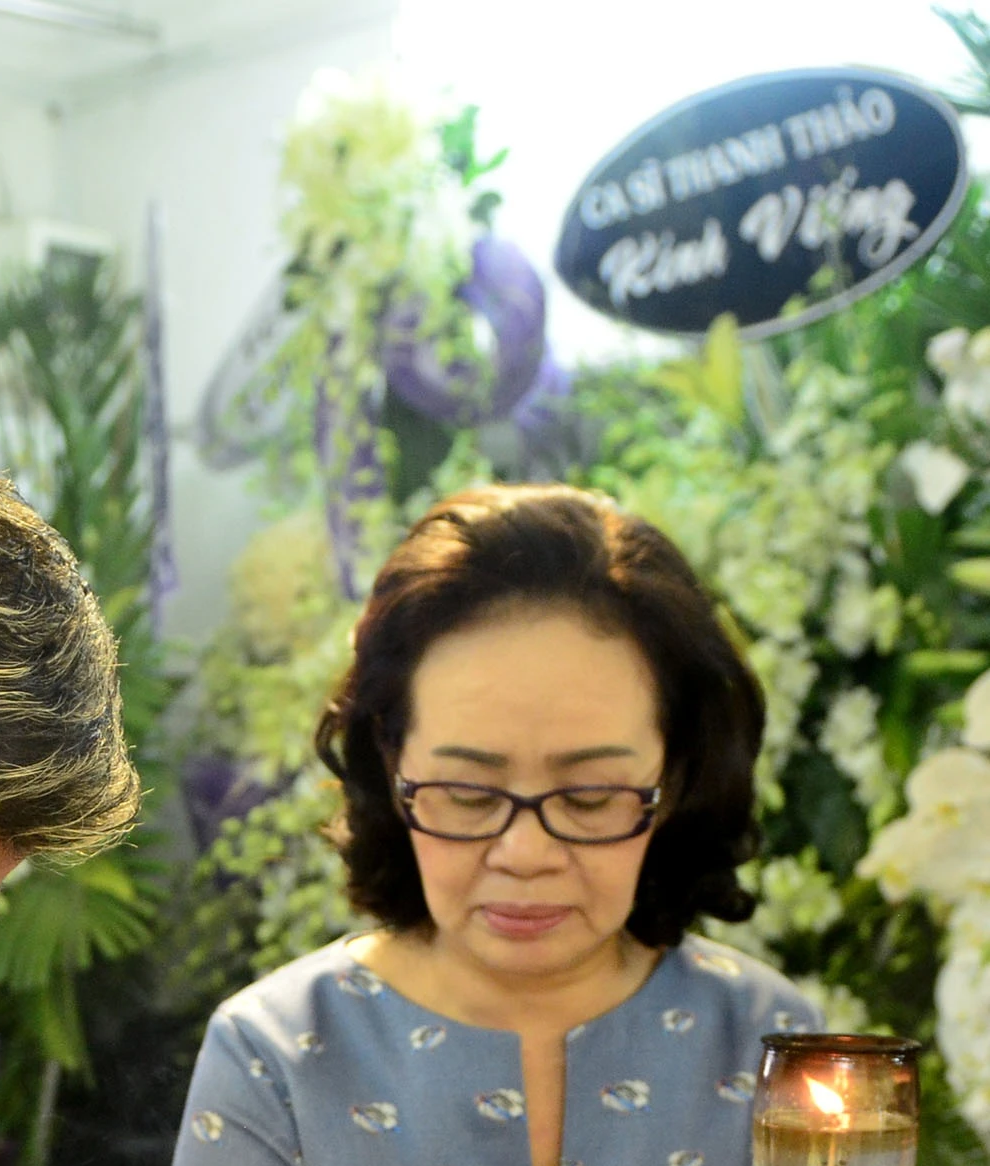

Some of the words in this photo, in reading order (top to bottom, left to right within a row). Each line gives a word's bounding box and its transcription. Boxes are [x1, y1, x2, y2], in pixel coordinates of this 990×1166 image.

[580, 179, 630, 230] CA
[664, 122, 786, 201] THANH
[781, 84, 896, 160] THẢO
